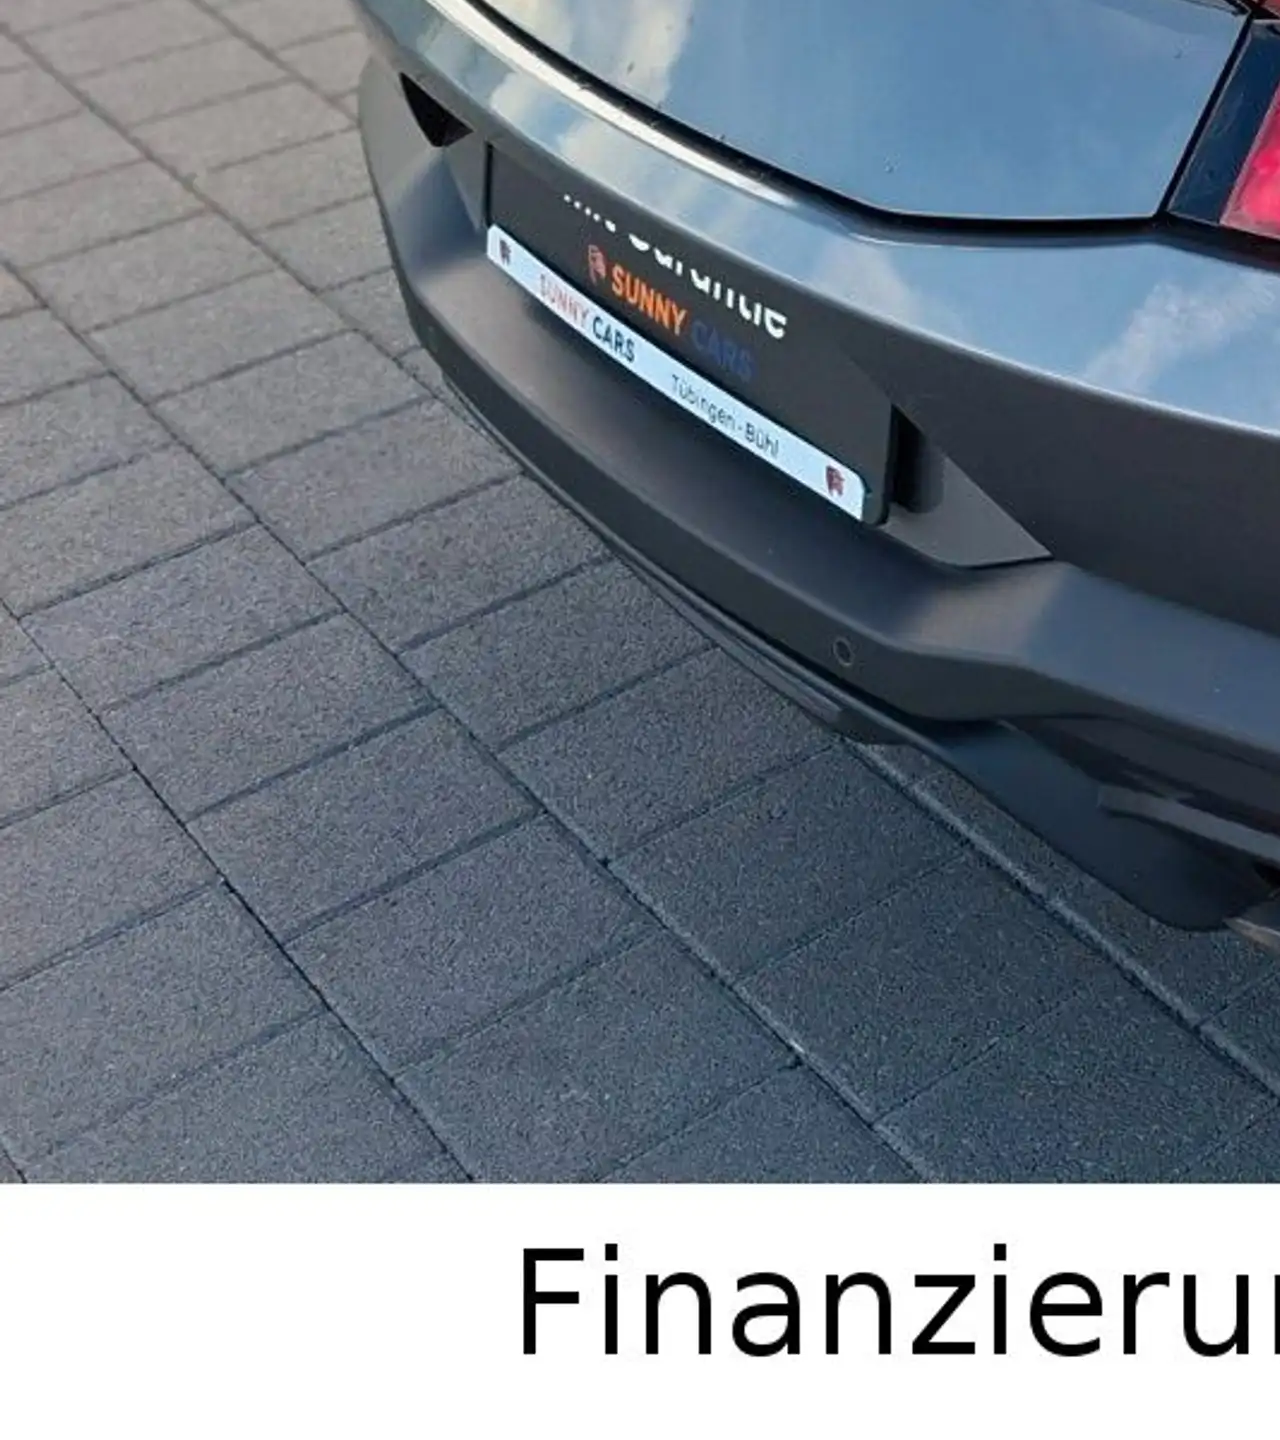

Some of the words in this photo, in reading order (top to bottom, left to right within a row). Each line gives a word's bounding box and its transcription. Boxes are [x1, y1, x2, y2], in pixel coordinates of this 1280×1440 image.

[593, 316, 635, 363] CARS
[611, 264, 687, 335] SUNNY
[691, 319, 757, 381] CARS
